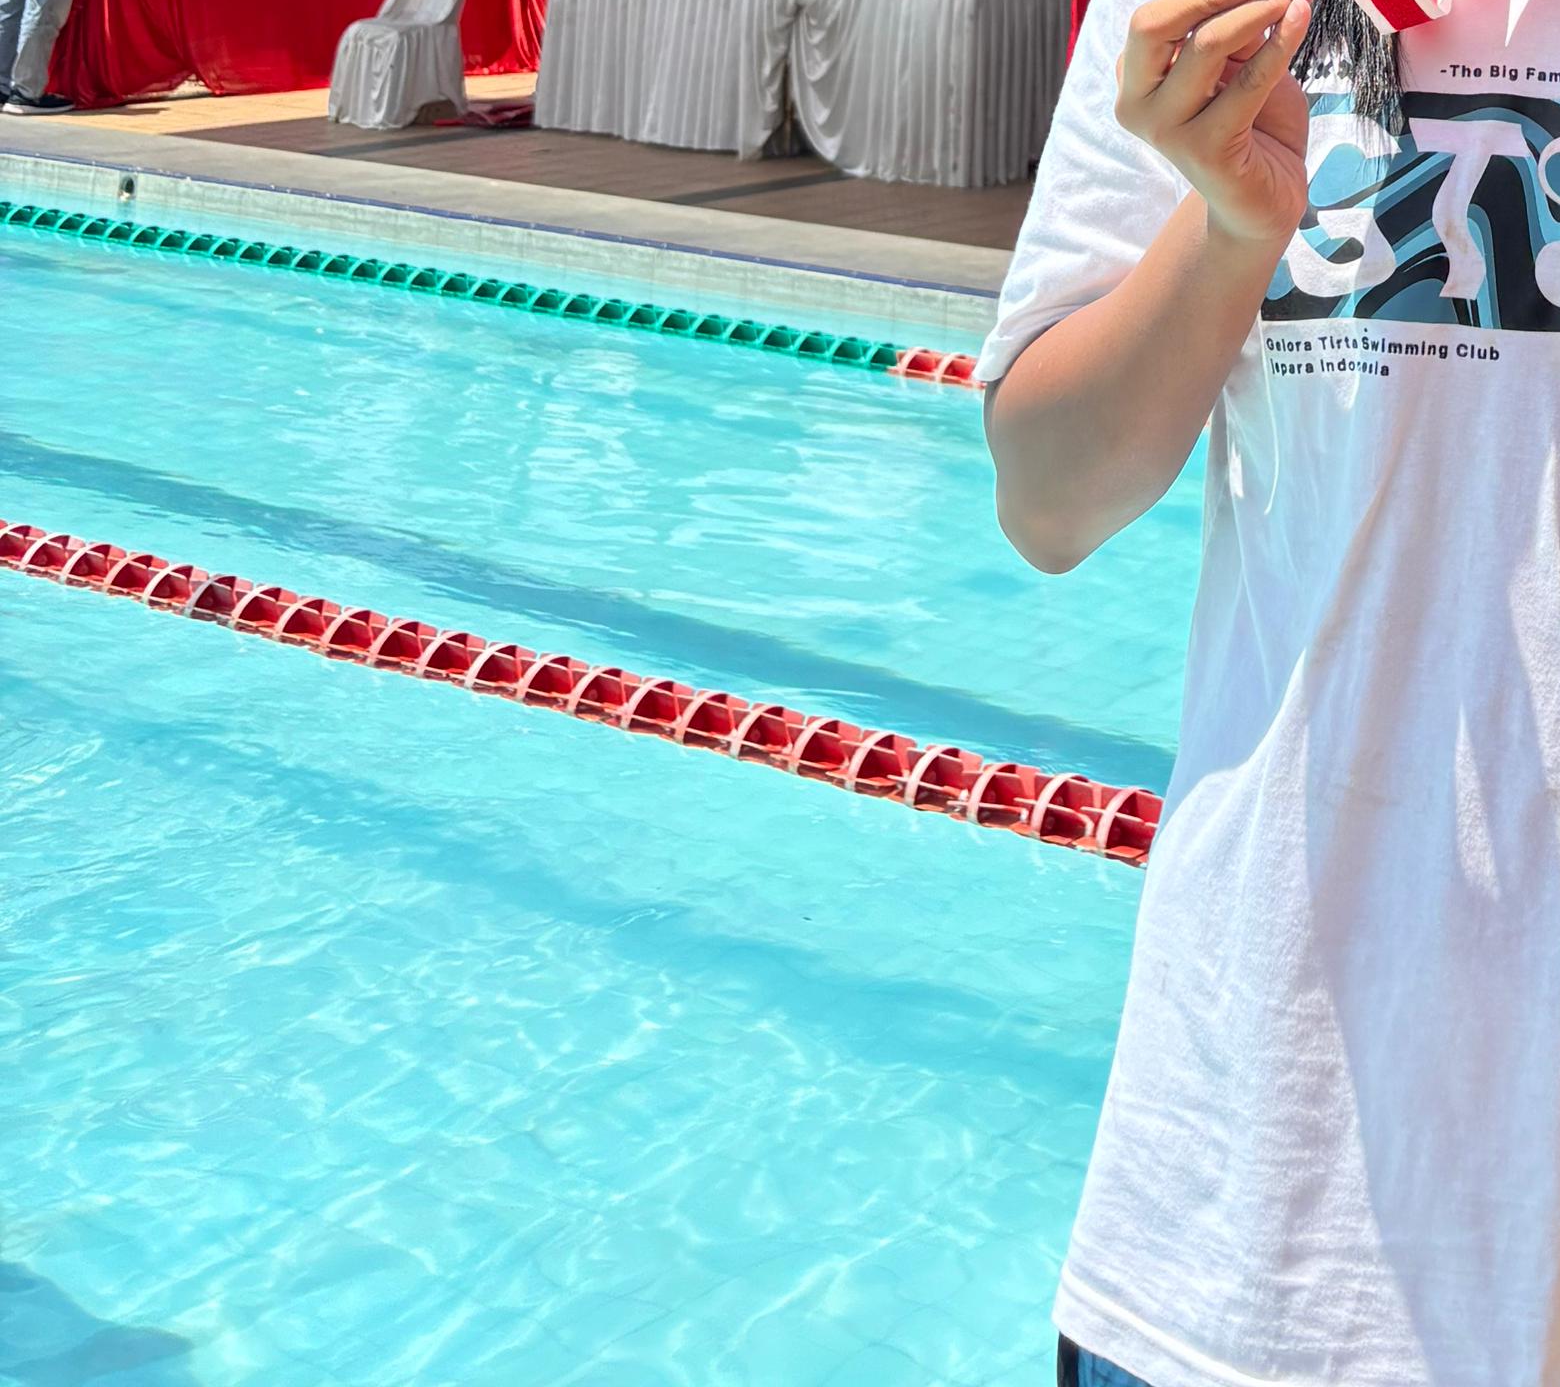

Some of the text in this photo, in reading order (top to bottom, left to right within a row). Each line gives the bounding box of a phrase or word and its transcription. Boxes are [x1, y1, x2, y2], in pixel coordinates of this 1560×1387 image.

[1490, 64, 1519, 82] Big
[1266, 335, 1501, 362] Gelora Tirta Swimming Club
